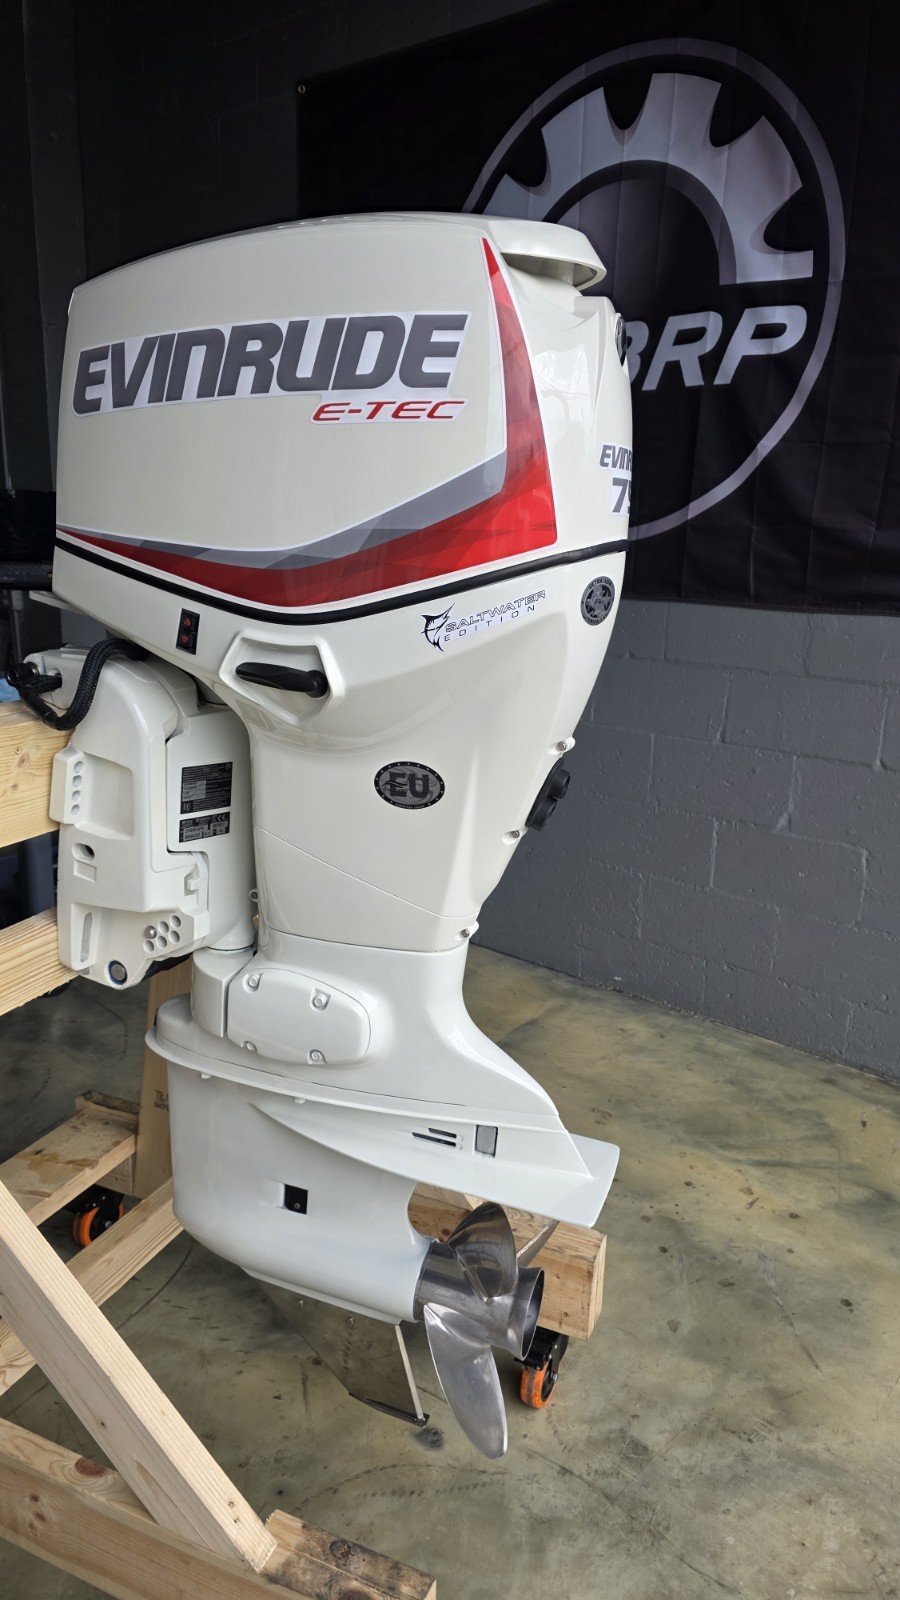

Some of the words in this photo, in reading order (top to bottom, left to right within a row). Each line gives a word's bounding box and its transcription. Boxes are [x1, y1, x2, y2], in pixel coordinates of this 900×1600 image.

[73, 314, 469, 415] EVINRUDE
[313, 400, 466, 421] E-TEC
[444, 604, 535, 642] EDITION
[445, 589, 546, 633] SALTWATER
[389, 771, 429, 799] EU
